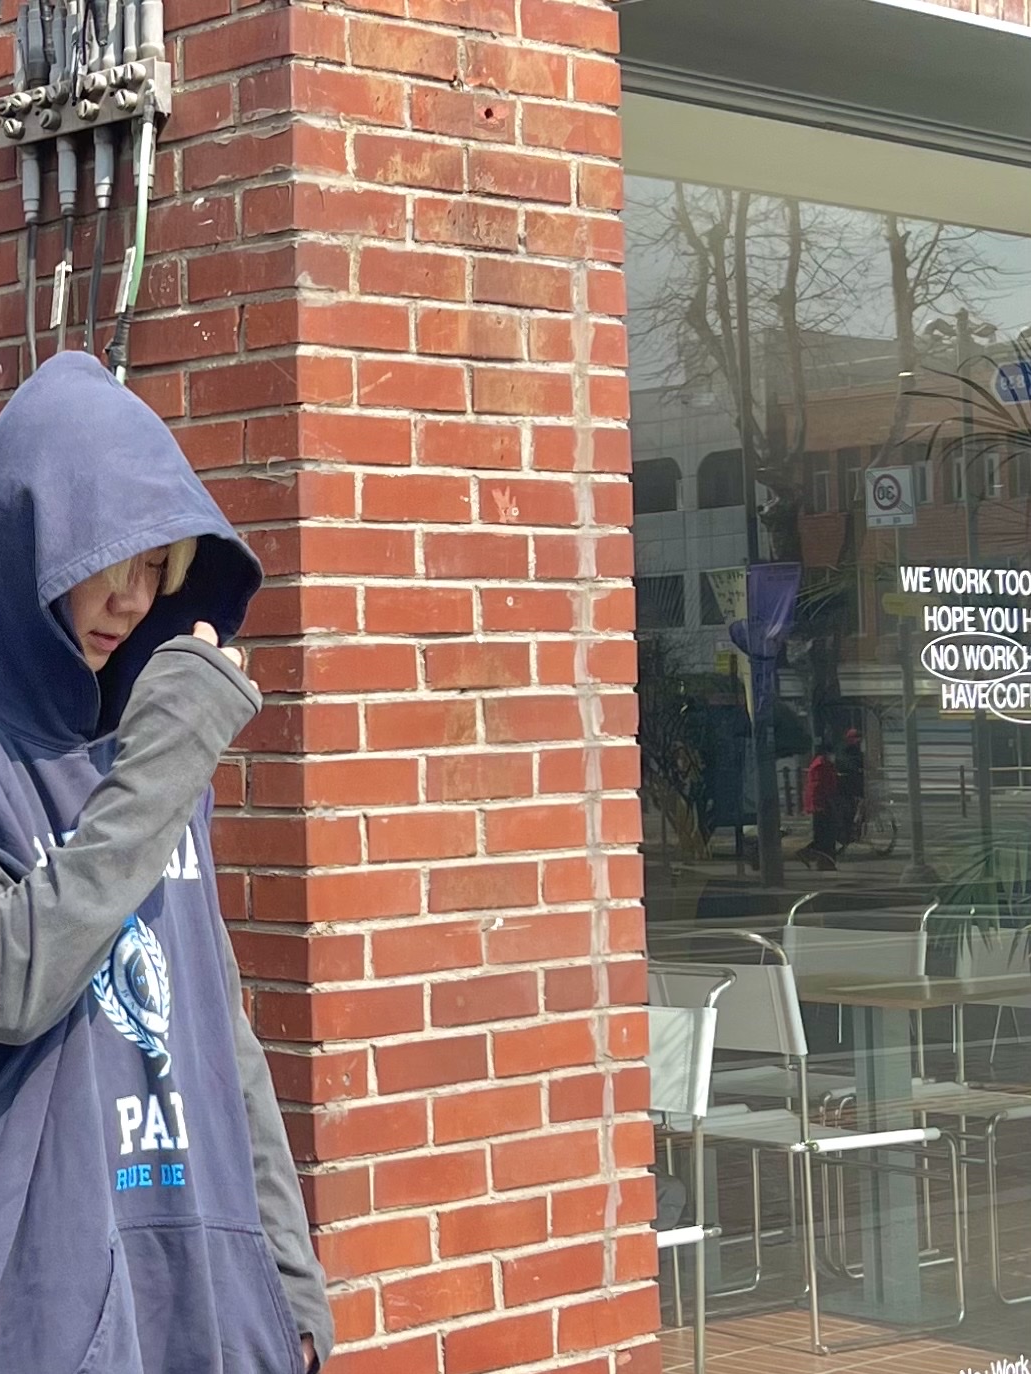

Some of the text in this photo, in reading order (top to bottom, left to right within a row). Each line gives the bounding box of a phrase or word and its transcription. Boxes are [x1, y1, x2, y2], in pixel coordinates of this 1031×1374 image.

[900, 566, 1031, 596] WE WORK TOO
[923, 605, 976, 632] HOPE
[978, 607, 1019, 633] YOU
[930, 644, 959, 671] NO
[962, 644, 1019, 671] WORK
[941, 682, 1031, 709] HAVE COF
[161, 1164, 186, 1186] DE
